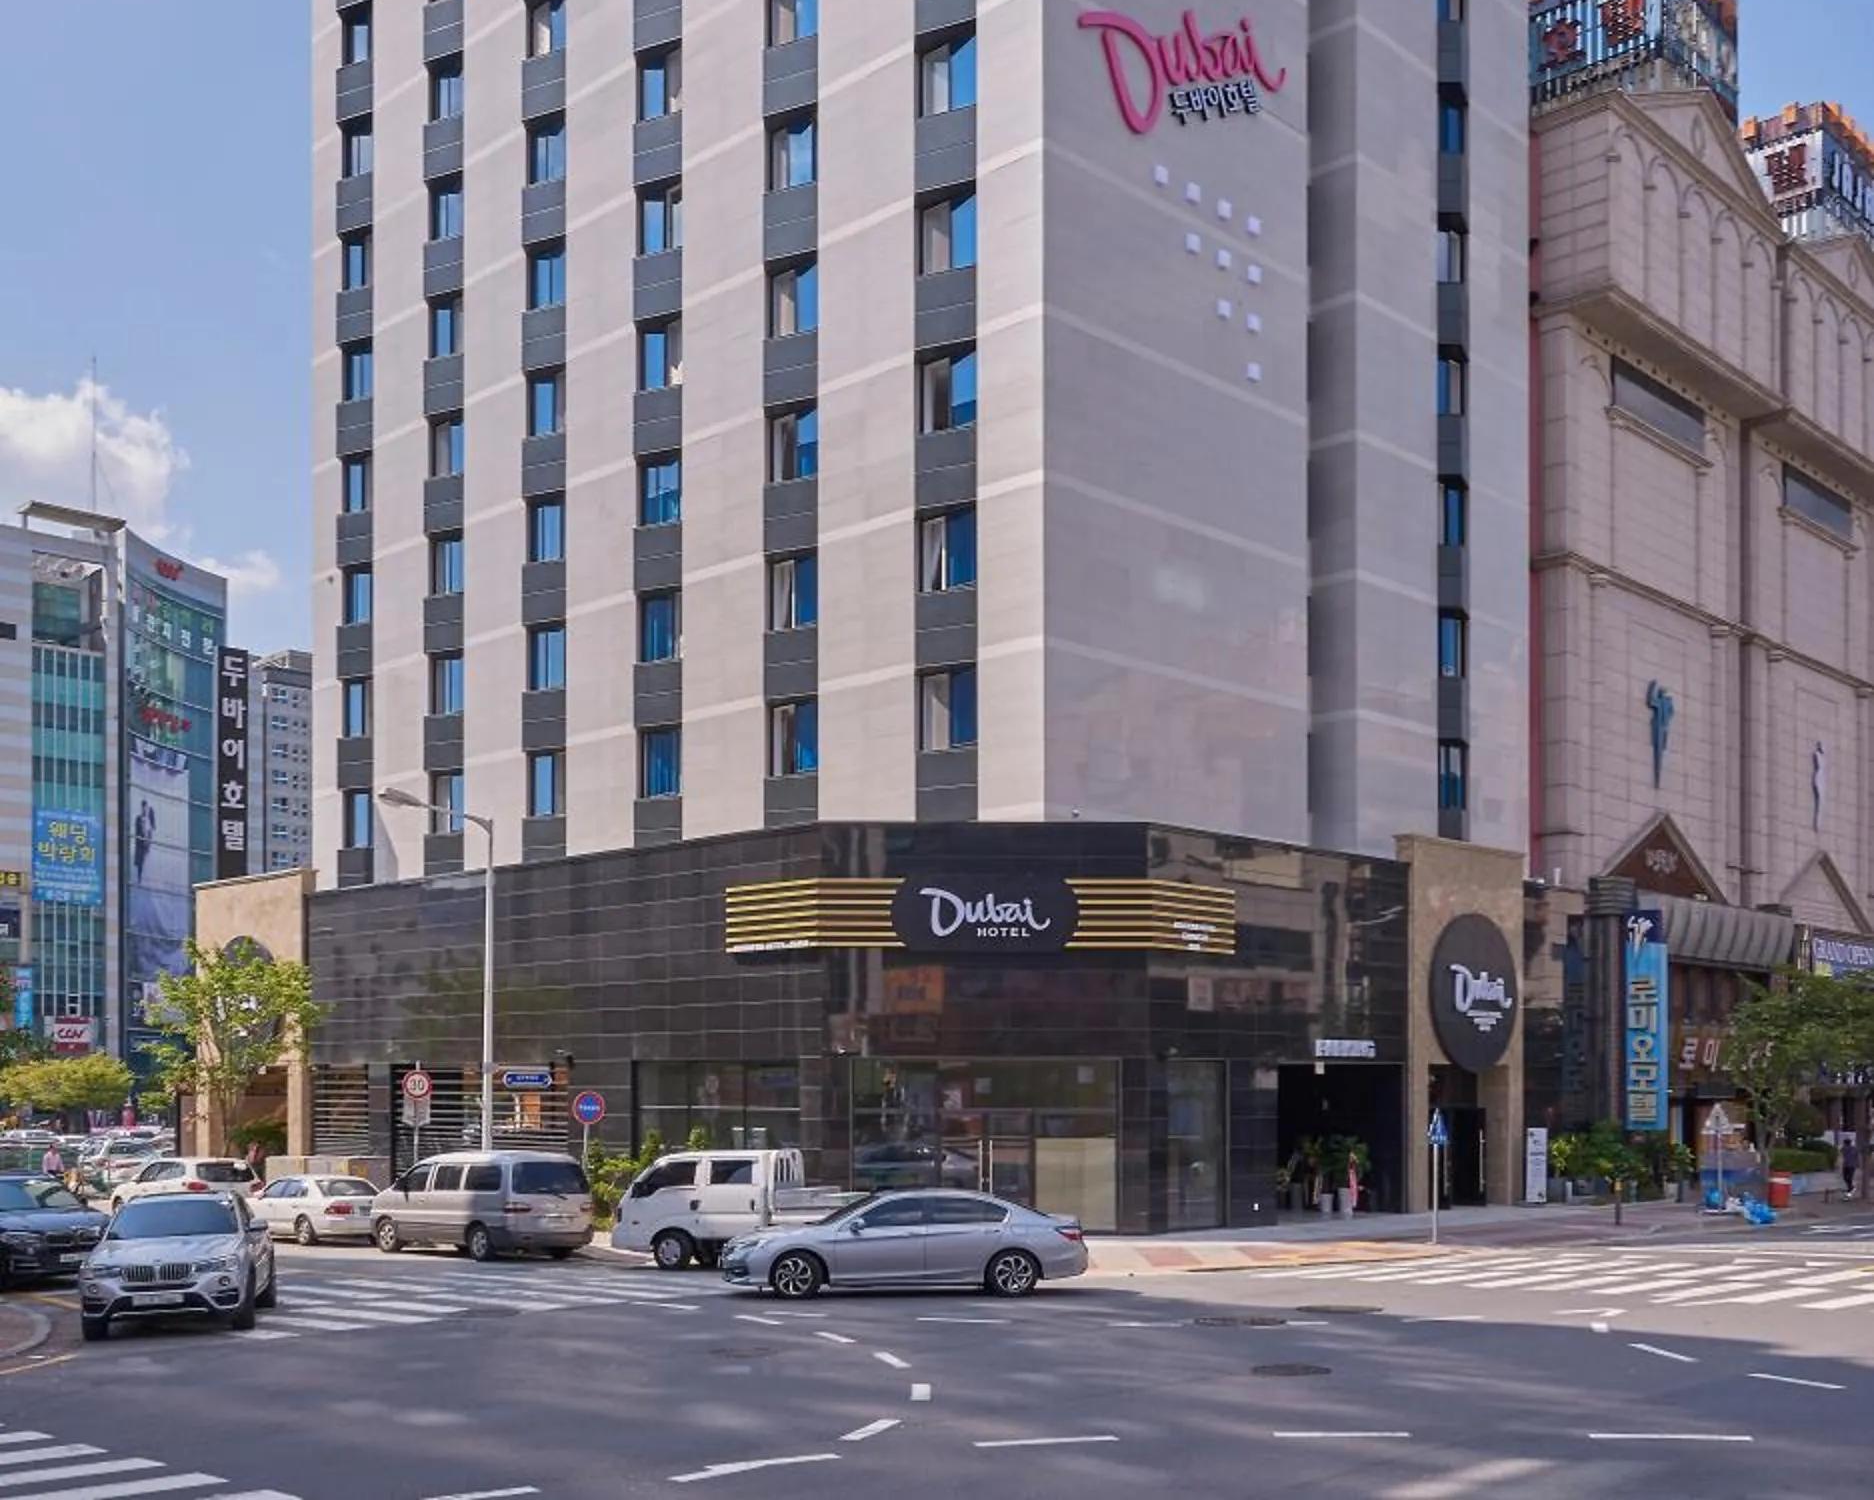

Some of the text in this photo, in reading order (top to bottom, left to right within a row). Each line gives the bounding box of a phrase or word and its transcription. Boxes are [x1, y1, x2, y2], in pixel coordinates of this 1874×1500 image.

[1077, 10, 1287, 134] Dubai
[1169, 81, 1260, 126] 두바이호텔
[221, 655, 246, 852] 두바이호텔
[919, 887, 1051, 937] Dubai
[977, 927, 1031, 937] HOTEL
[1627, 979, 1659, 1122] 로미오모텔
[409, 1078, 425, 1091] 30
